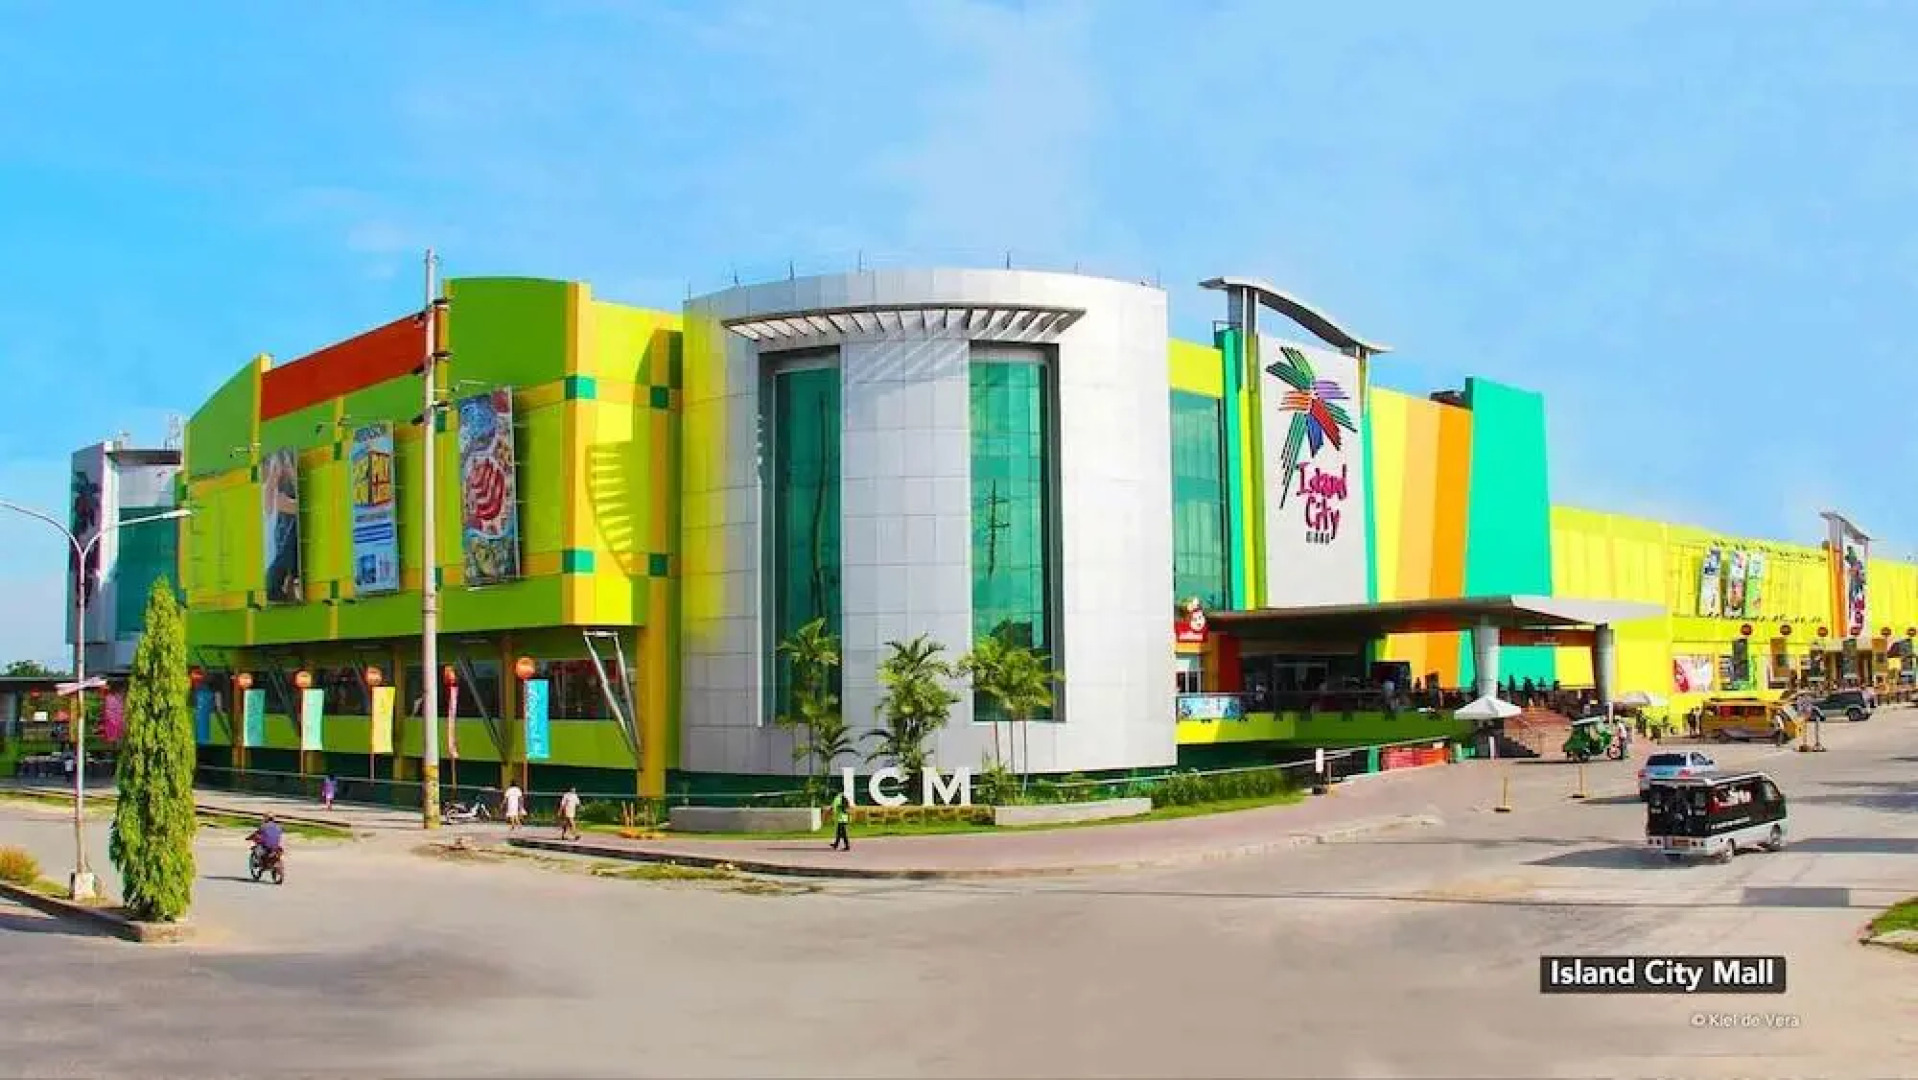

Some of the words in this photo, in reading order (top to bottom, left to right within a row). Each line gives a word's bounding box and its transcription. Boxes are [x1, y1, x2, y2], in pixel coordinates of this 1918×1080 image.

[1296, 462, 1347, 500] Island
[1305, 497, 1340, 539] City
[841, 767, 971, 807] ICM
